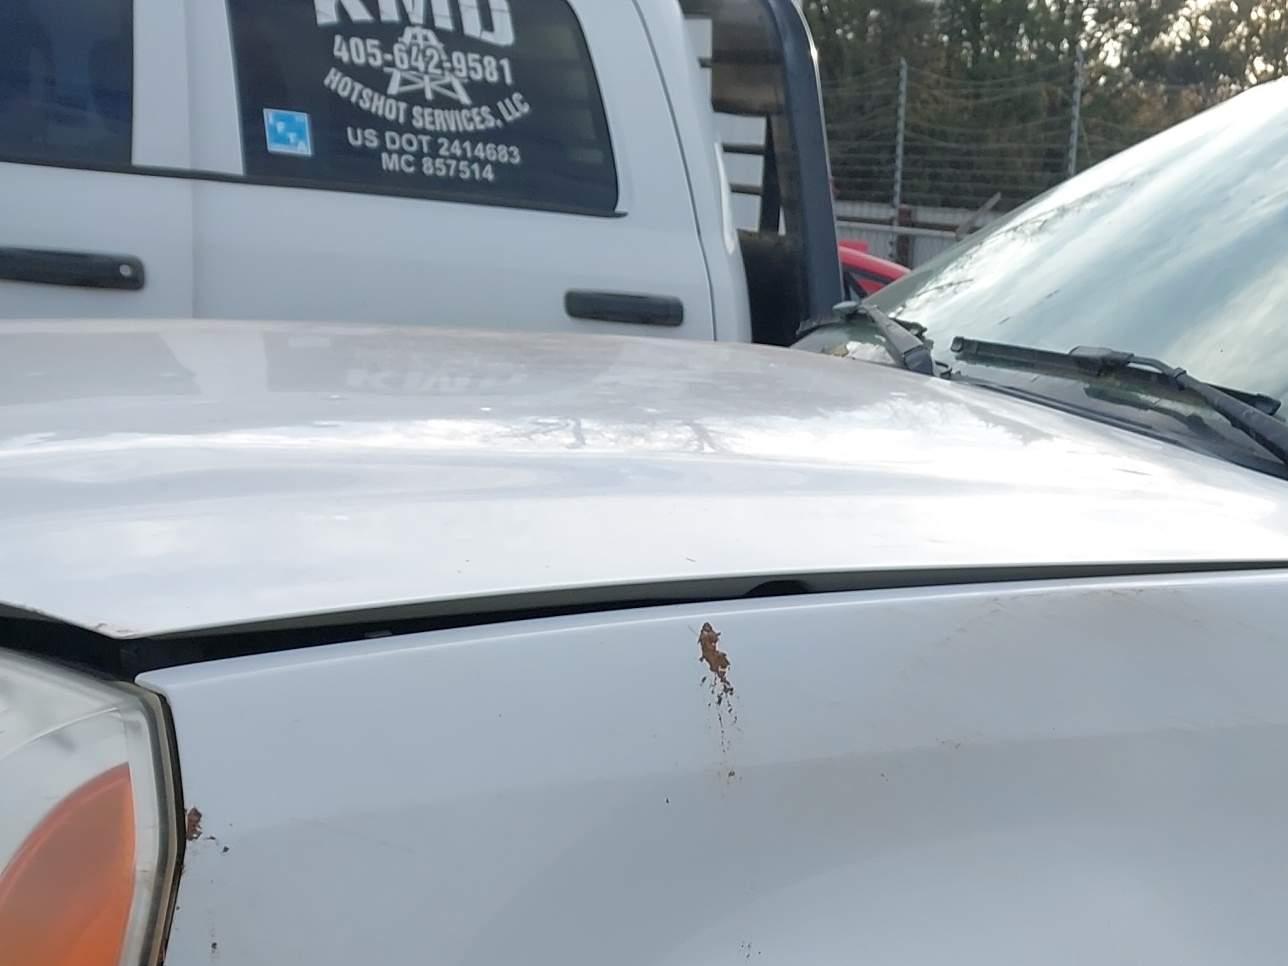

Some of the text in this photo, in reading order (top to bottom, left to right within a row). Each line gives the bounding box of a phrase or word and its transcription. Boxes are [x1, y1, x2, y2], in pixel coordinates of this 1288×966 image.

[333, 34, 513, 85] 405-642-9581
[323, 66, 408, 124] HOTSHOT
[496, 91, 531, 122] LLC
[347, 126, 379, 148] US
[384, 130, 432, 153] DOT
[381, 151, 495, 182] MC 857514
